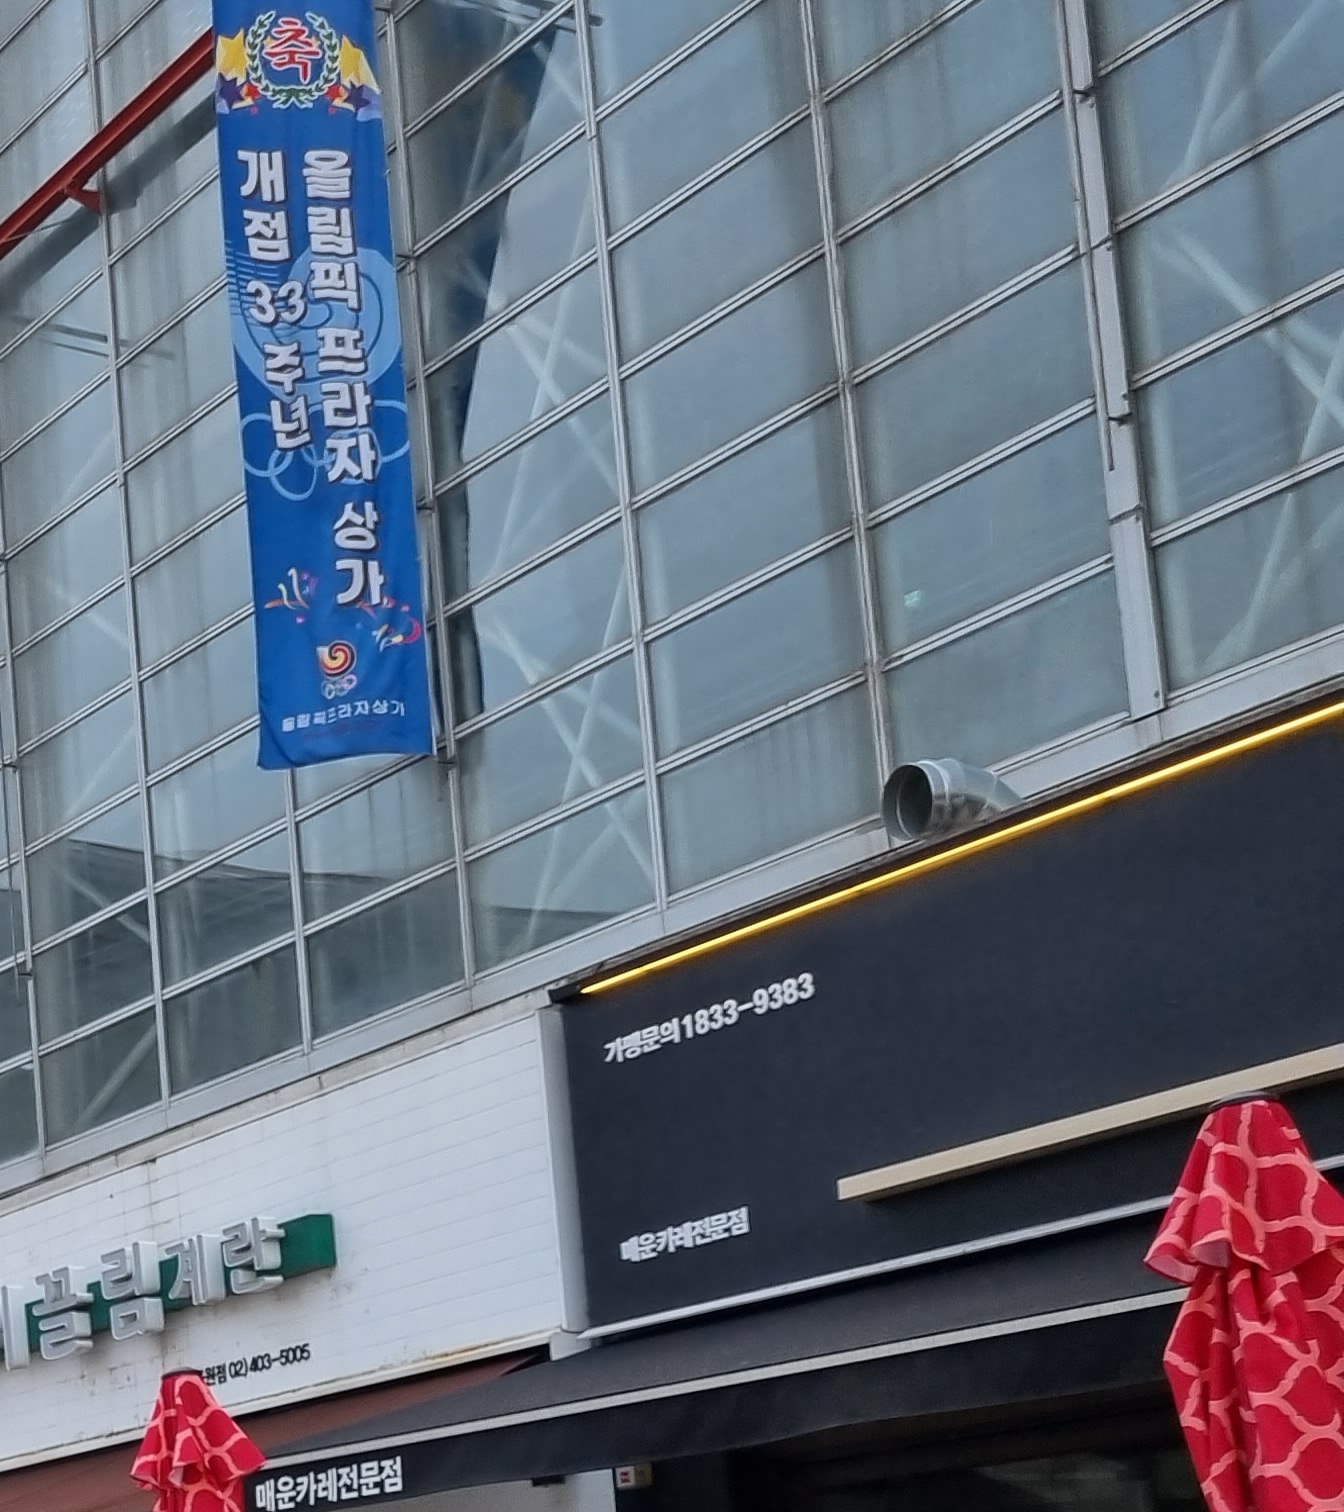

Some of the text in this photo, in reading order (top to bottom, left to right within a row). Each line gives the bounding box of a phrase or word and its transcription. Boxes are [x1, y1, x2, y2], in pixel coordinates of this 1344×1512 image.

[264, 17, 321, 85] 축
[238, 150, 312, 449] 개점 33 주년
[302, 150, 385, 606] 올림픽 프라자 상가
[619, 1205, 751, 1263] 매운카레전문점
[201, 1362, 227, 1387] 원점
[255, 1456, 403, 1512] 매운카레전문점
